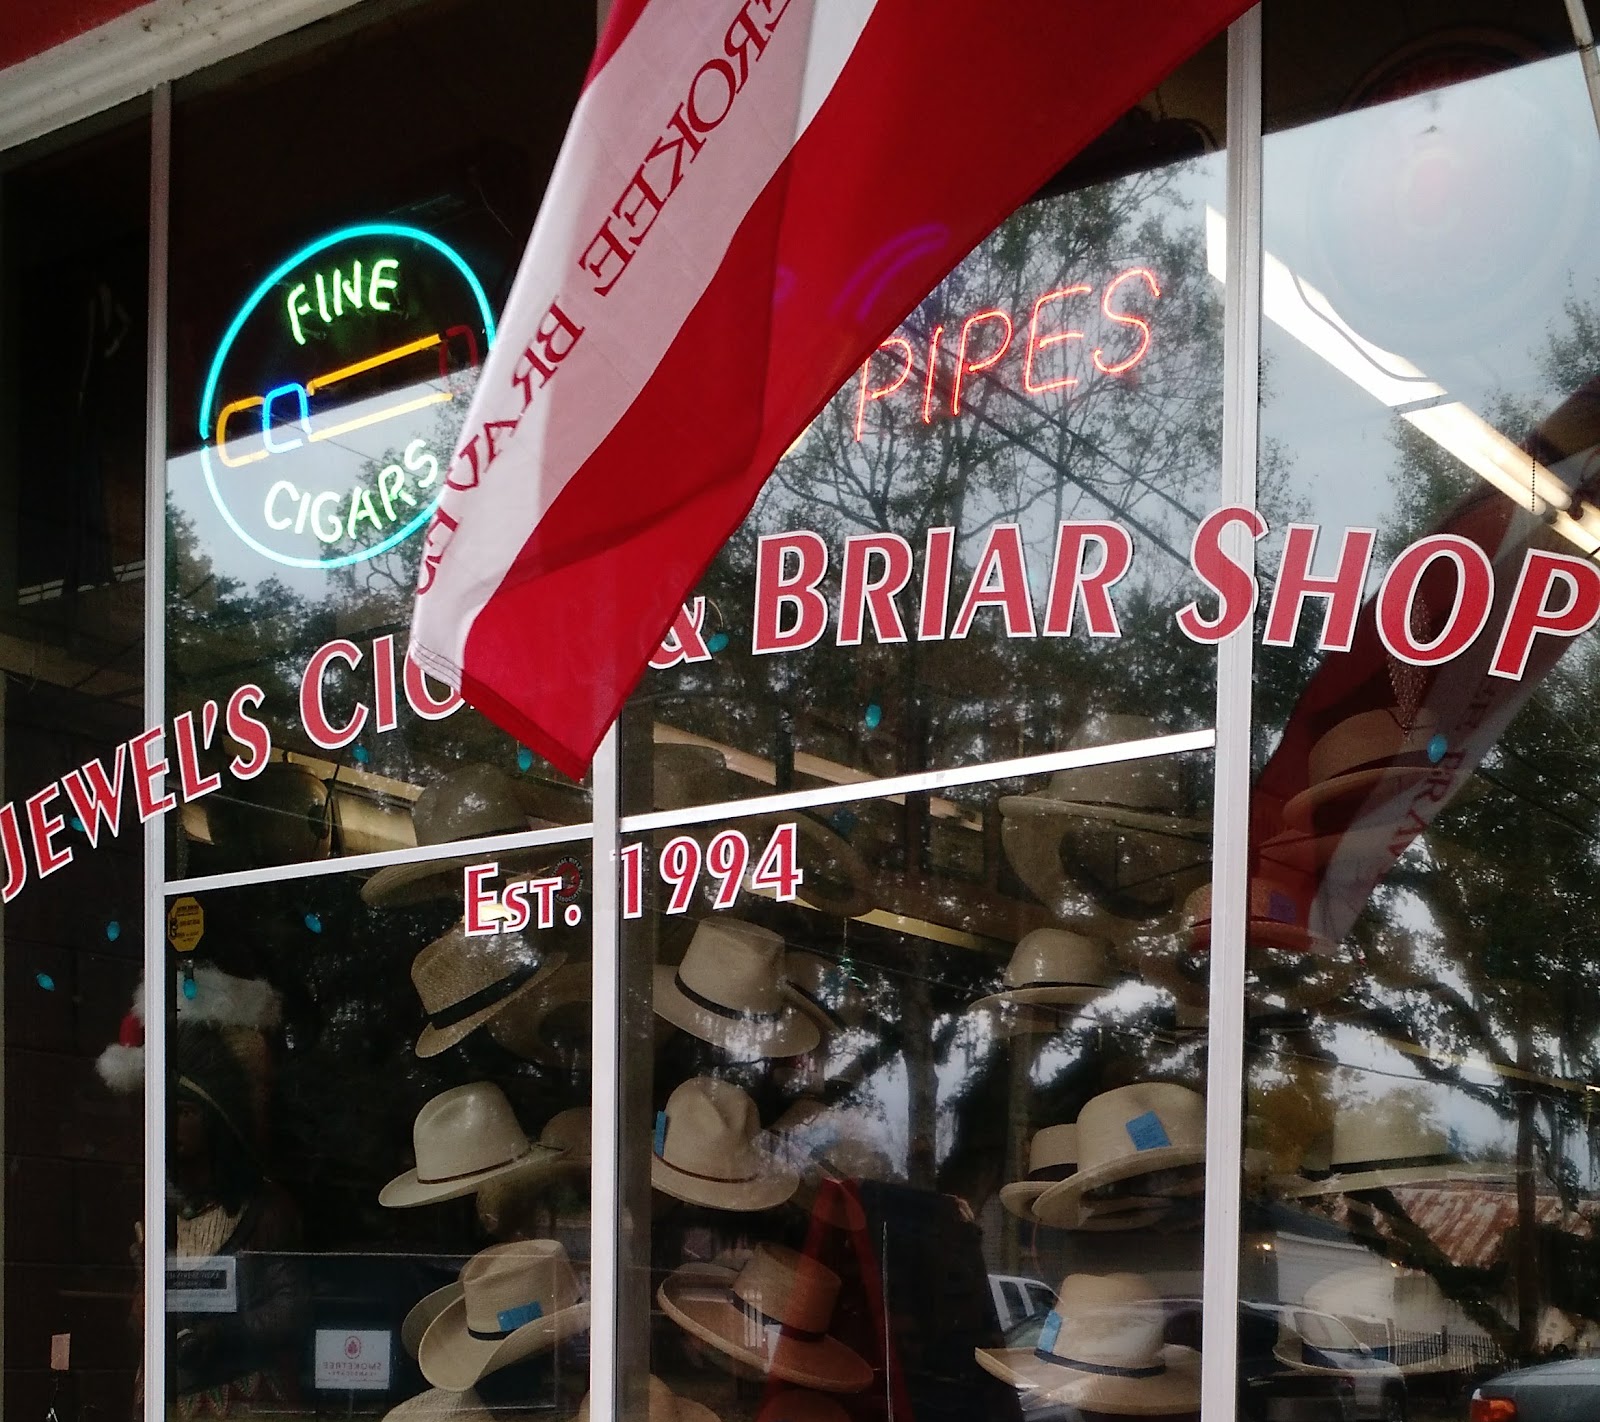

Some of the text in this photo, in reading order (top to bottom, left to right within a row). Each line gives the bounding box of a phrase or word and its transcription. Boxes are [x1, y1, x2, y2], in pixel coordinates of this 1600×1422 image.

[287, 259, 399, 346] FINE
[856, 267, 1161, 442] PIPES
[264, 438, 438, 544] CIGARS
[0, 684, 271, 903] JEWEL'S
[752, 519, 1134, 656] BRIAR
[1176, 506, 1600, 681] SHOP
[609, 822, 803, 919] 1994
